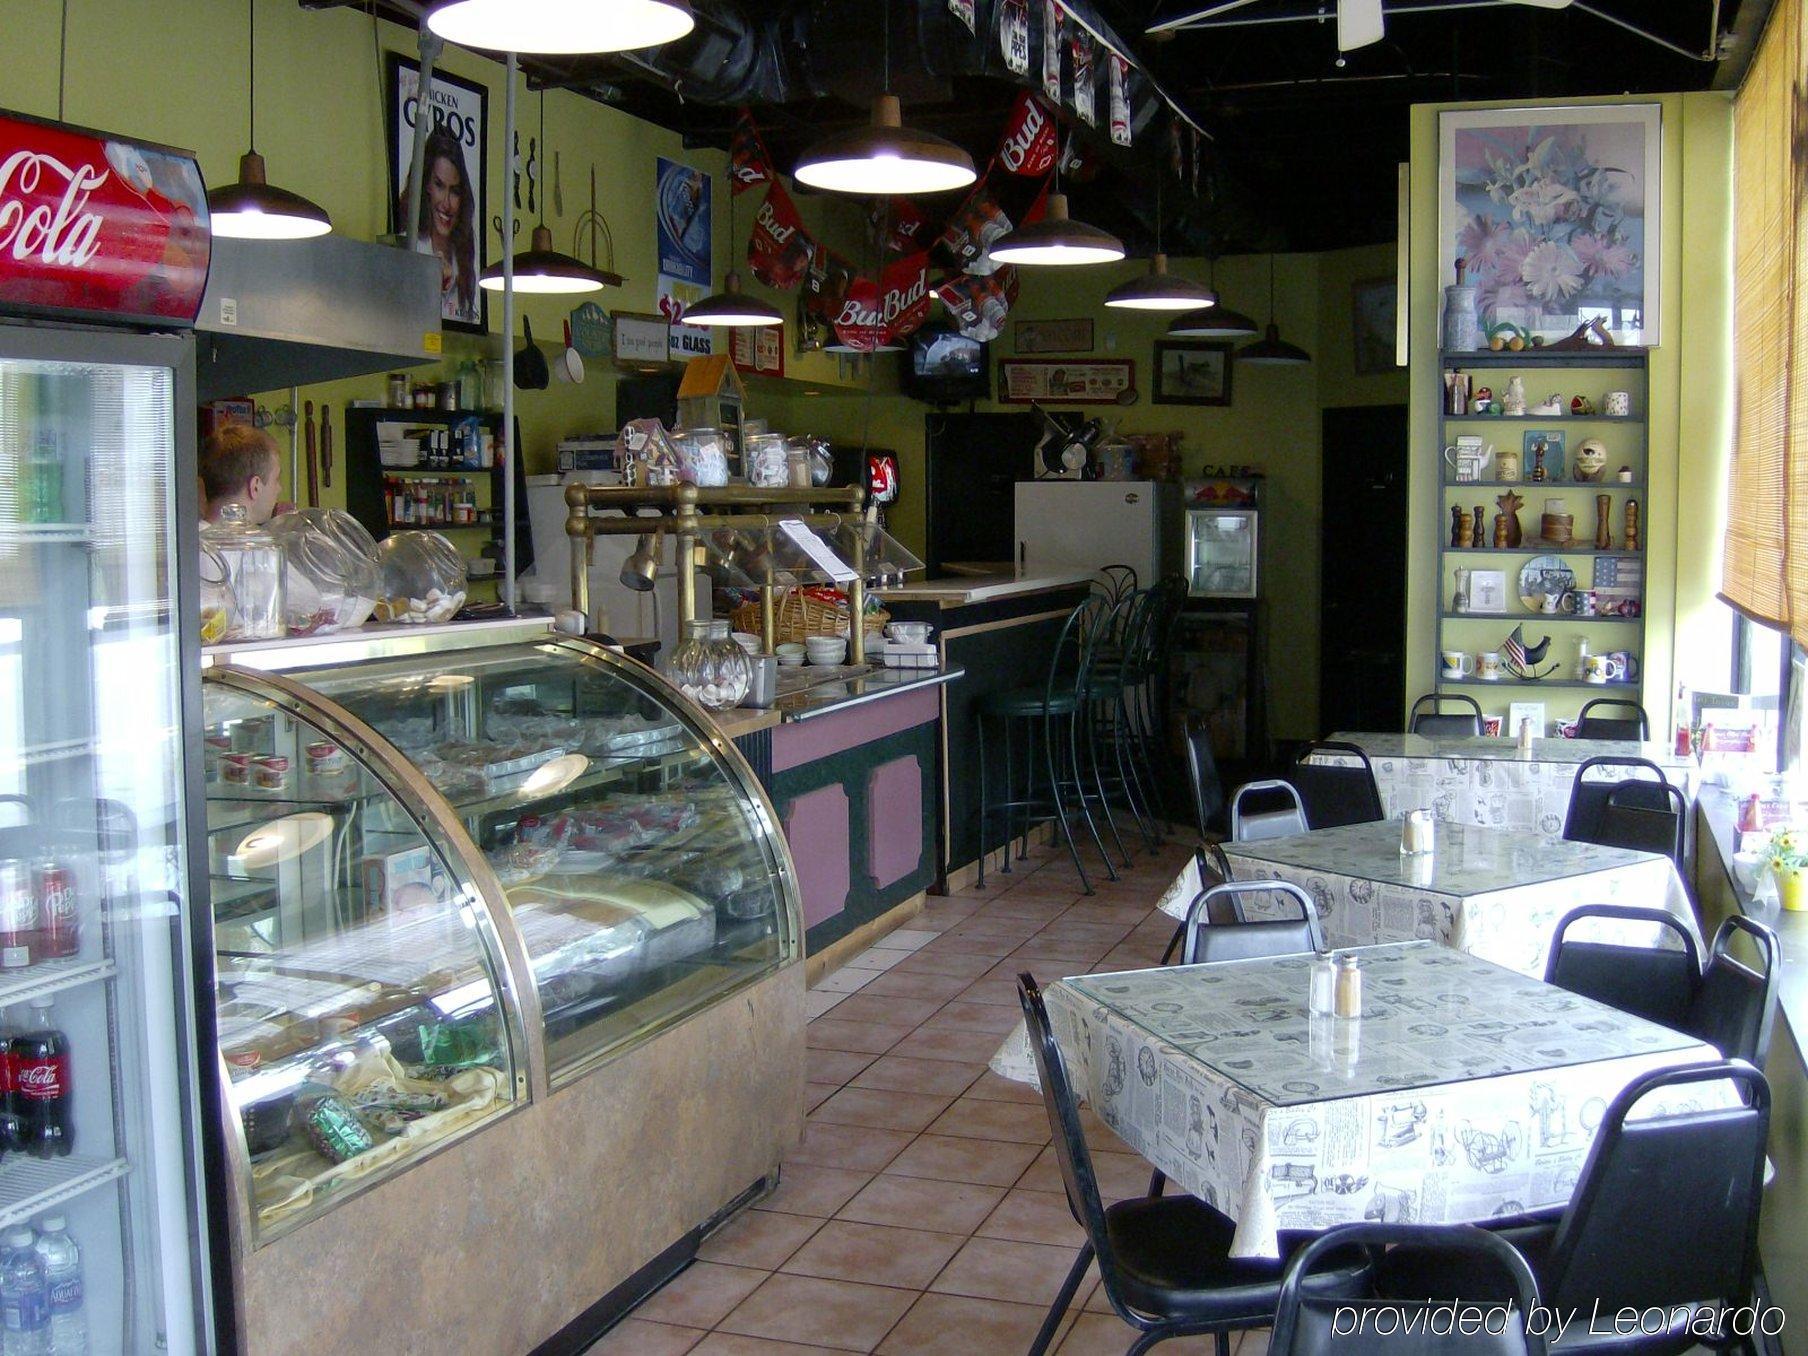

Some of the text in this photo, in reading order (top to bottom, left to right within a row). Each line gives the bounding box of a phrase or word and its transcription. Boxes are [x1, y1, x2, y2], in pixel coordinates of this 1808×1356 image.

[1001, 98, 1044, 172] Bud
[757, 201, 796, 244] Bud
[883, 267, 926, 323] Bud
[682, 334, 711, 355] GLASS
